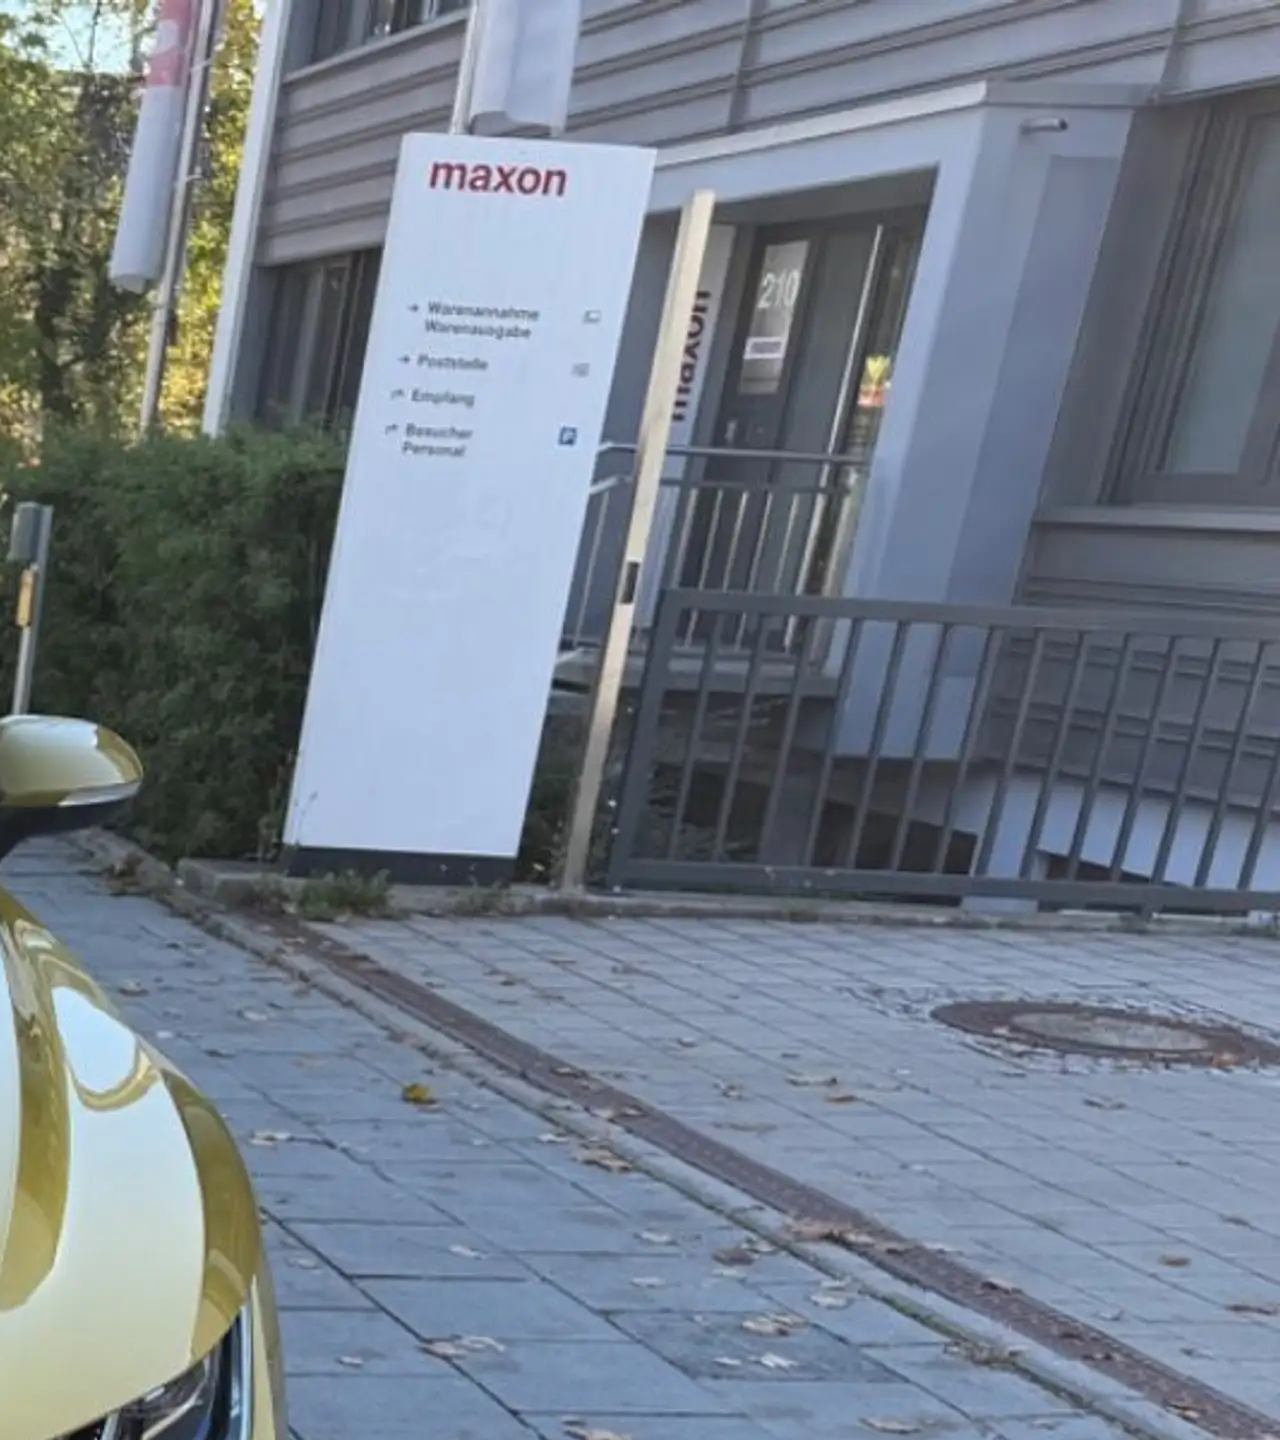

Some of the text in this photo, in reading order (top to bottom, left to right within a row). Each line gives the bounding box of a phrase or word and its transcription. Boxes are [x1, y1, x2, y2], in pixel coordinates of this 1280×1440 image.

[428, 160, 567, 197] maxon
[428, 301, 540, 321] Warenannahme
[417, 354, 489, 371] Poststelle
[411, 389, 476, 408] Empfang
[405, 423, 474, 440] Besucher
[402, 441, 466, 458] Personal
